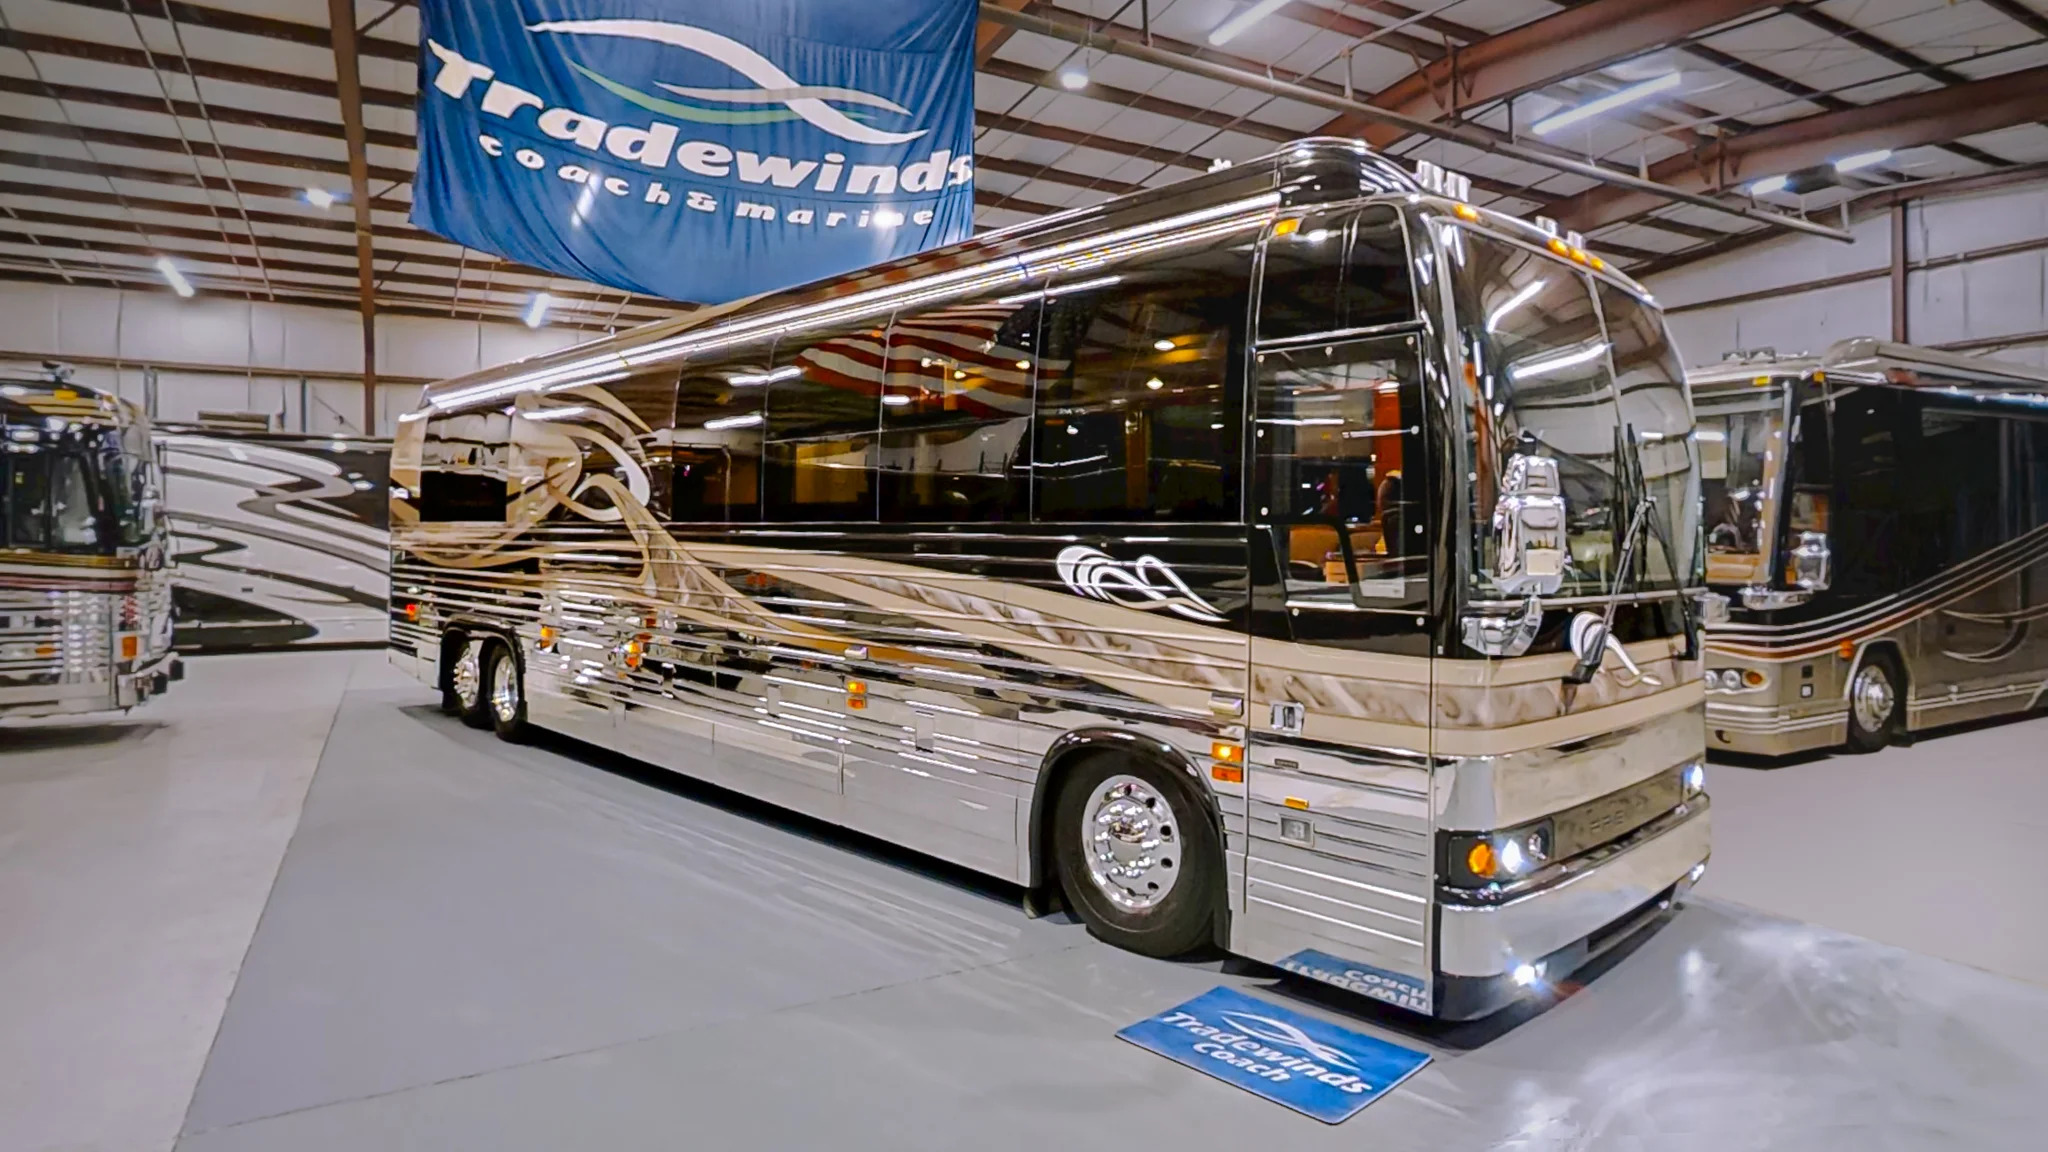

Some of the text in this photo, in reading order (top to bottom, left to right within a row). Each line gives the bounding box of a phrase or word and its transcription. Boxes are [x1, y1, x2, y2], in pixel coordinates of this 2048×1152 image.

[427, 38, 974, 195] Tradewinds
[479, 134, 670, 206] coach
[686, 190, 718, 213] &
[1162, 1010, 1373, 1095] Tradewinds
[1193, 1042, 1292, 1083] Coach
